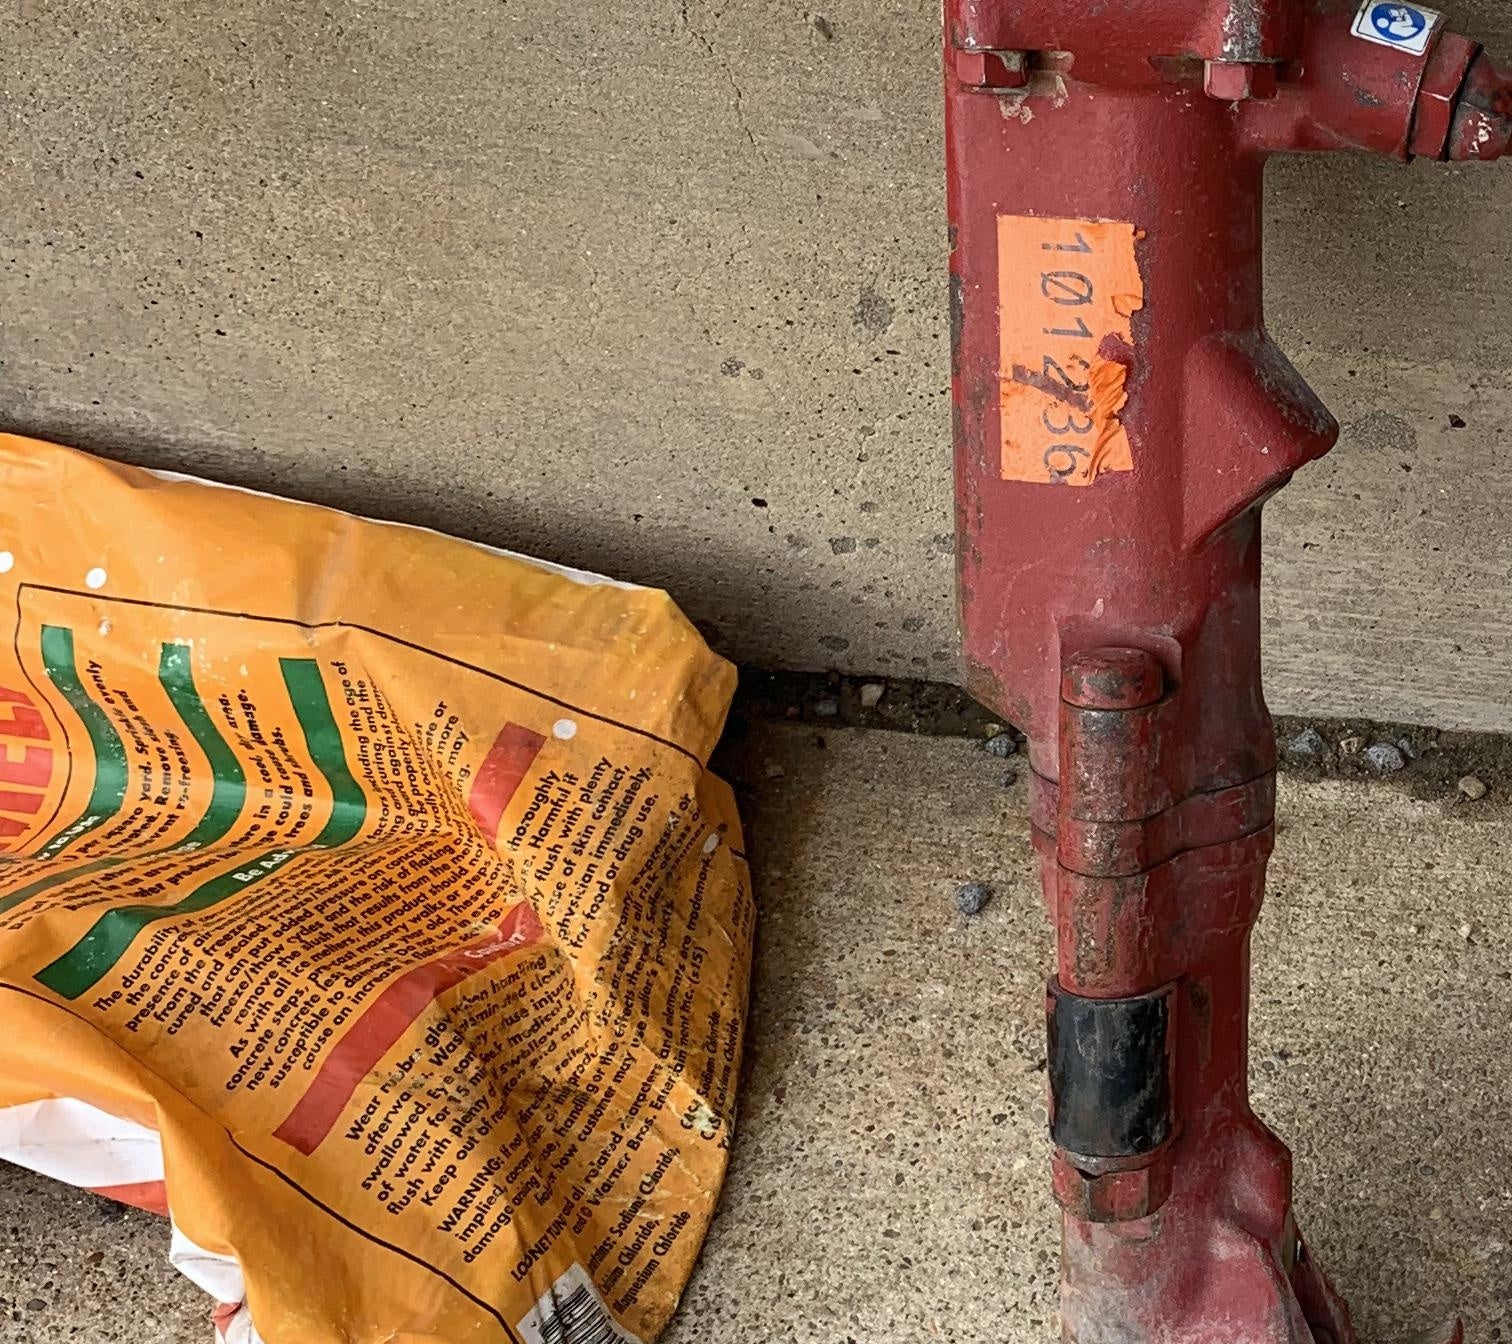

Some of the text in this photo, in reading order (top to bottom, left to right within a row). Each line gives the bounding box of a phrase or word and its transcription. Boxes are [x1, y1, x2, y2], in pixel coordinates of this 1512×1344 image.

[356, 680, 368, 701] the
[364, 706, 377, 731] and
[153, 747, 168, 805] Remove
[382, 724, 399, 774] against
[136, 760, 155, 803] yard.
[274, 784, 293, 827] could
[285, 769, 314, 840] trees and
[633, 790, 659, 824] use.
[94, 659, 361, 1012] The durability the age of
[253, 801, 272, 822] in
[400, 820, 414, 835] to
[527, 770, 579, 850] Harmful if
[197, 983, 226, 1018] that
[223, 956, 248, 984] can
[248, 934, 272, 959] put
[271, 906, 311, 941] added
[314, 875, 366, 915] pressure
[367, 866, 384, 883] on
[433, 700, 449, 719] or
[610, 822, 643, 862] drug
[232, 968, 279, 1026] remove
[276, 945, 300, 970] the
[302, 927, 332, 954] slush
[334, 912, 358, 935] that
[359, 888, 400, 921] results
[397, 870, 427, 895] from
[430, 859, 451, 878] the
[444, 730, 470, 765] may
[235, 864, 262, 885] Be
[603, 862, 620, 880] or
[582, 879, 610, 921] food
[175, 946, 194, 967] of
[209, 939, 285, 1028] freeze/thaw
[324, 901, 348, 925] and
[349, 888, 371, 908] the
[371, 873, 396, 896] risk
[395, 864, 411, 881] of
[409, 840, 453, 872] flaking
[227, 1035, 249, 1058] As
[243, 997, 273, 1035] with
[270, 976, 291, 999] all
[288, 956, 310, 978] ice
[310, 932, 359, 965] melters,
[358, 917, 380, 939] this
[382, 888, 426, 927] product
[428, 862, 466, 898] should
[125, 979, 151, 1007] the
[125, 966, 181, 1033] presence
[153, 983, 187, 1023] from
[182, 956, 207, 984] the
[165, 917, 270, 1037] cured and sealed.
[224, 1026, 274, 1092] concrete
[270, 981, 310, 1027] steps,
[408, 895, 445, 927] walks
[446, 888, 461, 903] or
[245, 1055, 275, 1091] new
[271, 990, 321, 1056] concrete
[448, 883, 484, 917] These
[360, 754, 613, 1192] swallowed. Eye flush with plenty
[374, 761, 630, 1203] of water for 15 of skin contact,
[267, 1004, 331, 1090] susceptible
[326, 987, 344, 1006] to
[300, 959, 402, 1071] cause an increase
[437, 1154, 506, 1235] WARNING:
[677, 792, 693, 811] or
[655, 1028, 675, 1059] and
[345, 1093, 383, 1143] Wear
[576, 1051, 637, 1143] customer may
[454, 1134, 479, 1162] out
[460, 1202, 516, 1266] damage
[591, 1066, 605, 1083] or
[598, 1039, 621, 1067] the
[475, 1117, 494, 1137] of
[626, 1110, 658, 1151] Bros.
[386, 1174, 424, 1217] flush
[419, 1135, 451, 1176] with
[420, 1161, 459, 1207] Keep
[456, 1181, 509, 1245] implied,
[616, 1214, 661, 1268] Chloride,
[650, 1207, 691, 1258] Chloride
